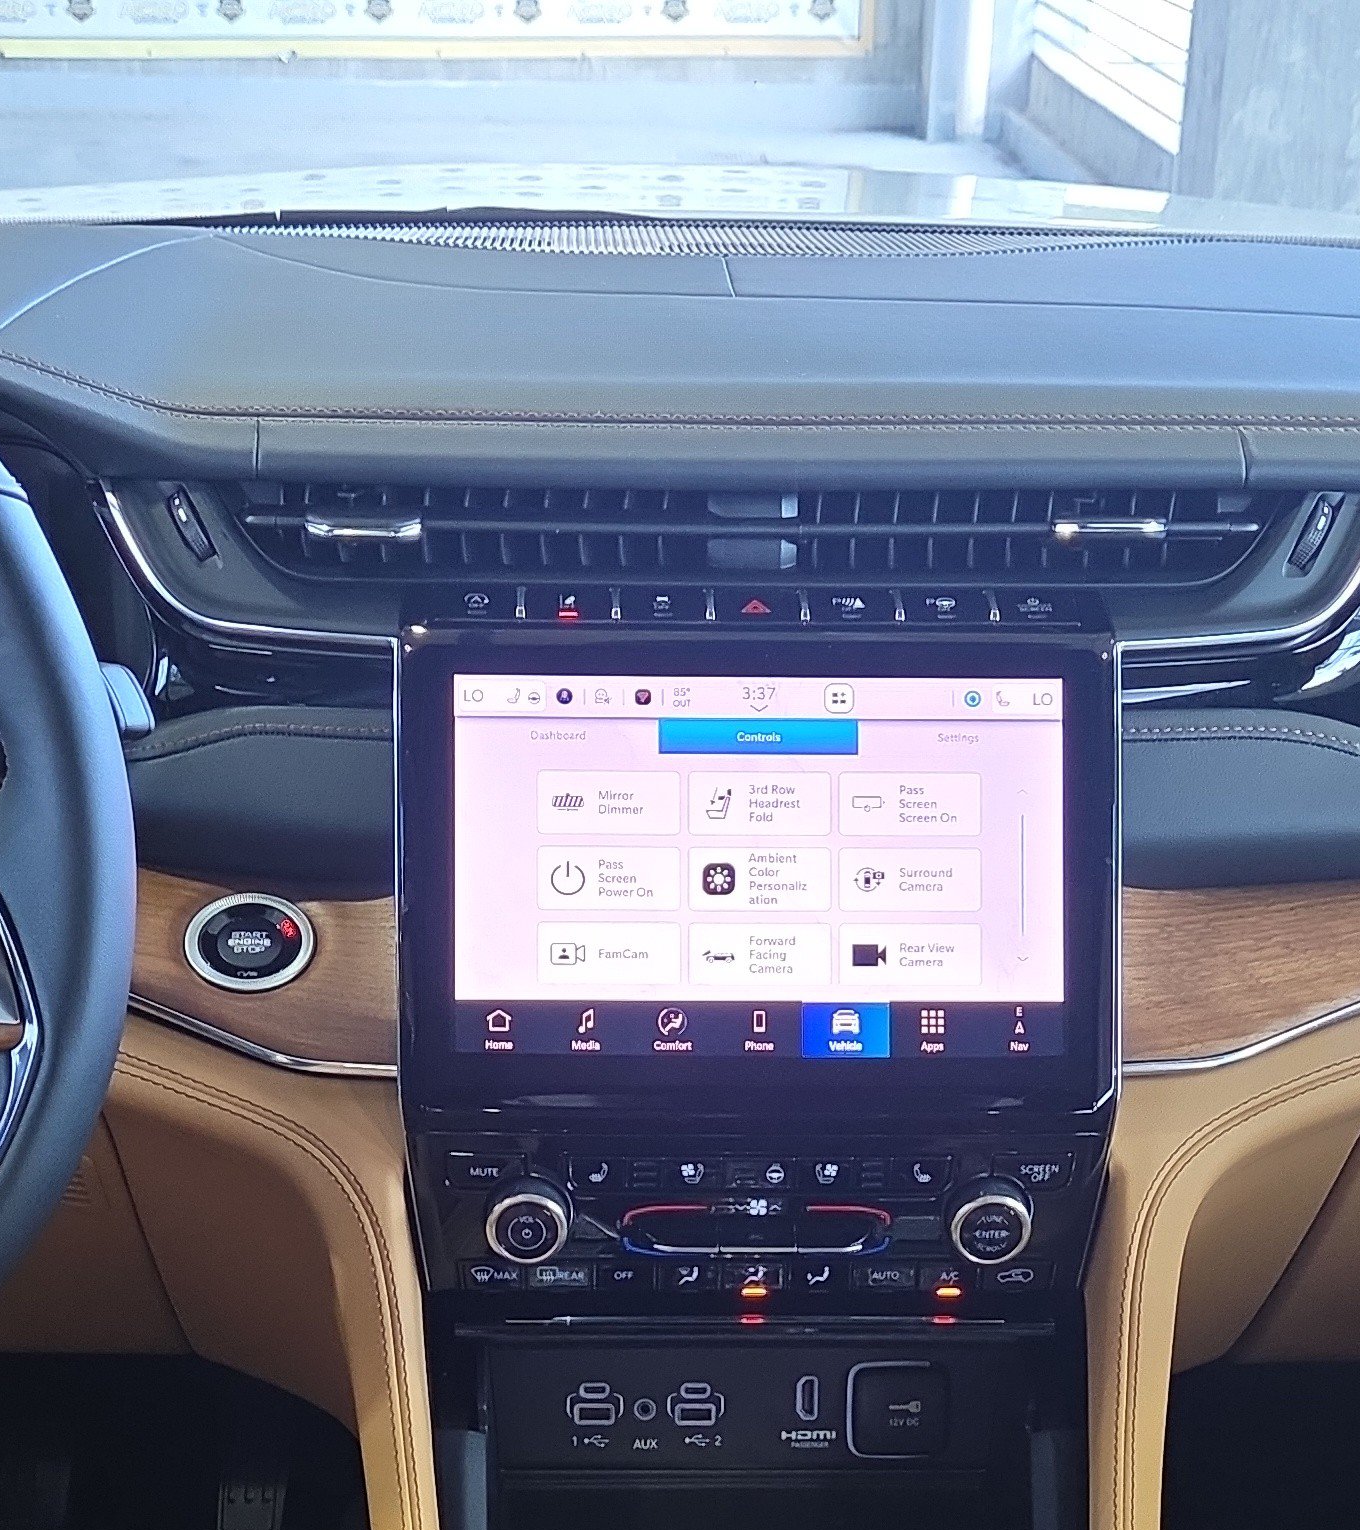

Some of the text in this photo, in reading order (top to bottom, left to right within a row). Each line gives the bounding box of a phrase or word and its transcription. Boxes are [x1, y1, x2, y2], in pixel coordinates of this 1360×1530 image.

[463, 689, 484, 702] LO
[673, 687, 691, 697] 85°
[742, 686, 776, 701] 3:37
[672, 699, 691, 708] OUT
[1033, 693, 1053, 705] LO
[530, 730, 586, 741] Dashboard
[736, 731, 782, 743] Controls
[937, 732, 980, 744] Settings
[749, 784, 796, 795] 3rd Row
[899, 785, 924, 796] Pass
[598, 790, 634, 801] Mirror
[749, 798, 801, 809] Headrest
[898, 799, 937, 810] Screen
[598, 804, 643, 815] Dimmer
[749, 812, 773, 823] Fold
[898, 813, 958, 823] Screen On
[748, 853, 797, 864] Ambient
[598, 859, 624, 870] Pass
[598, 873, 637, 883] Screen
[748, 867, 779, 878] Color
[899, 868, 953, 878] Surround
[749, 881, 807, 891] Personaliz
[899, 881, 943, 892] Camera
[598, 887, 654, 898] Power On
[748, 895, 778, 905] ation
[231, 931, 269, 939] START
[749, 935, 796, 946] Forward
[227, 938, 272, 947] ENGINE
[899, 943, 955, 953] Rear View
[233, 945, 266, 954] STOP
[598, 949, 649, 960] FamCam
[749, 950, 787, 961] Facing
[899, 956, 943, 967] Camera
[748, 963, 793, 974] Camera
[484, 1040, 514, 1051] Home
[571, 1040, 601, 1051] Media
[653, 1040, 693, 1051] Comfort
[744, 1040, 775, 1051] Phone
[828, 1040, 863, 1052] Vehicle
[920, 1041, 945, 1053] Apps
[1010, 1041, 1029, 1051] Nav
[469, 1167, 500, 1178] MUTE
[1019, 1164, 1060, 1176] SCREEN
[1031, 1172, 1050, 1182] OFF
[518, 1216, 535, 1224] VOL
[975, 1229, 1009, 1239] ENTER
[494, 1271, 518, 1280] MAX
[557, 1271, 585, 1280] REAR
[613, 1271, 634, 1280] OFF
[872, 1271, 899, 1280] AUTO
[940, 1271, 960, 1280] A/C
[571, 1435, 579, 1447] 1
[714, 1435, 722, 1447] 2
[780, 1430, 837, 1441] HDMI
[632, 1438, 658, 1450] AUX
